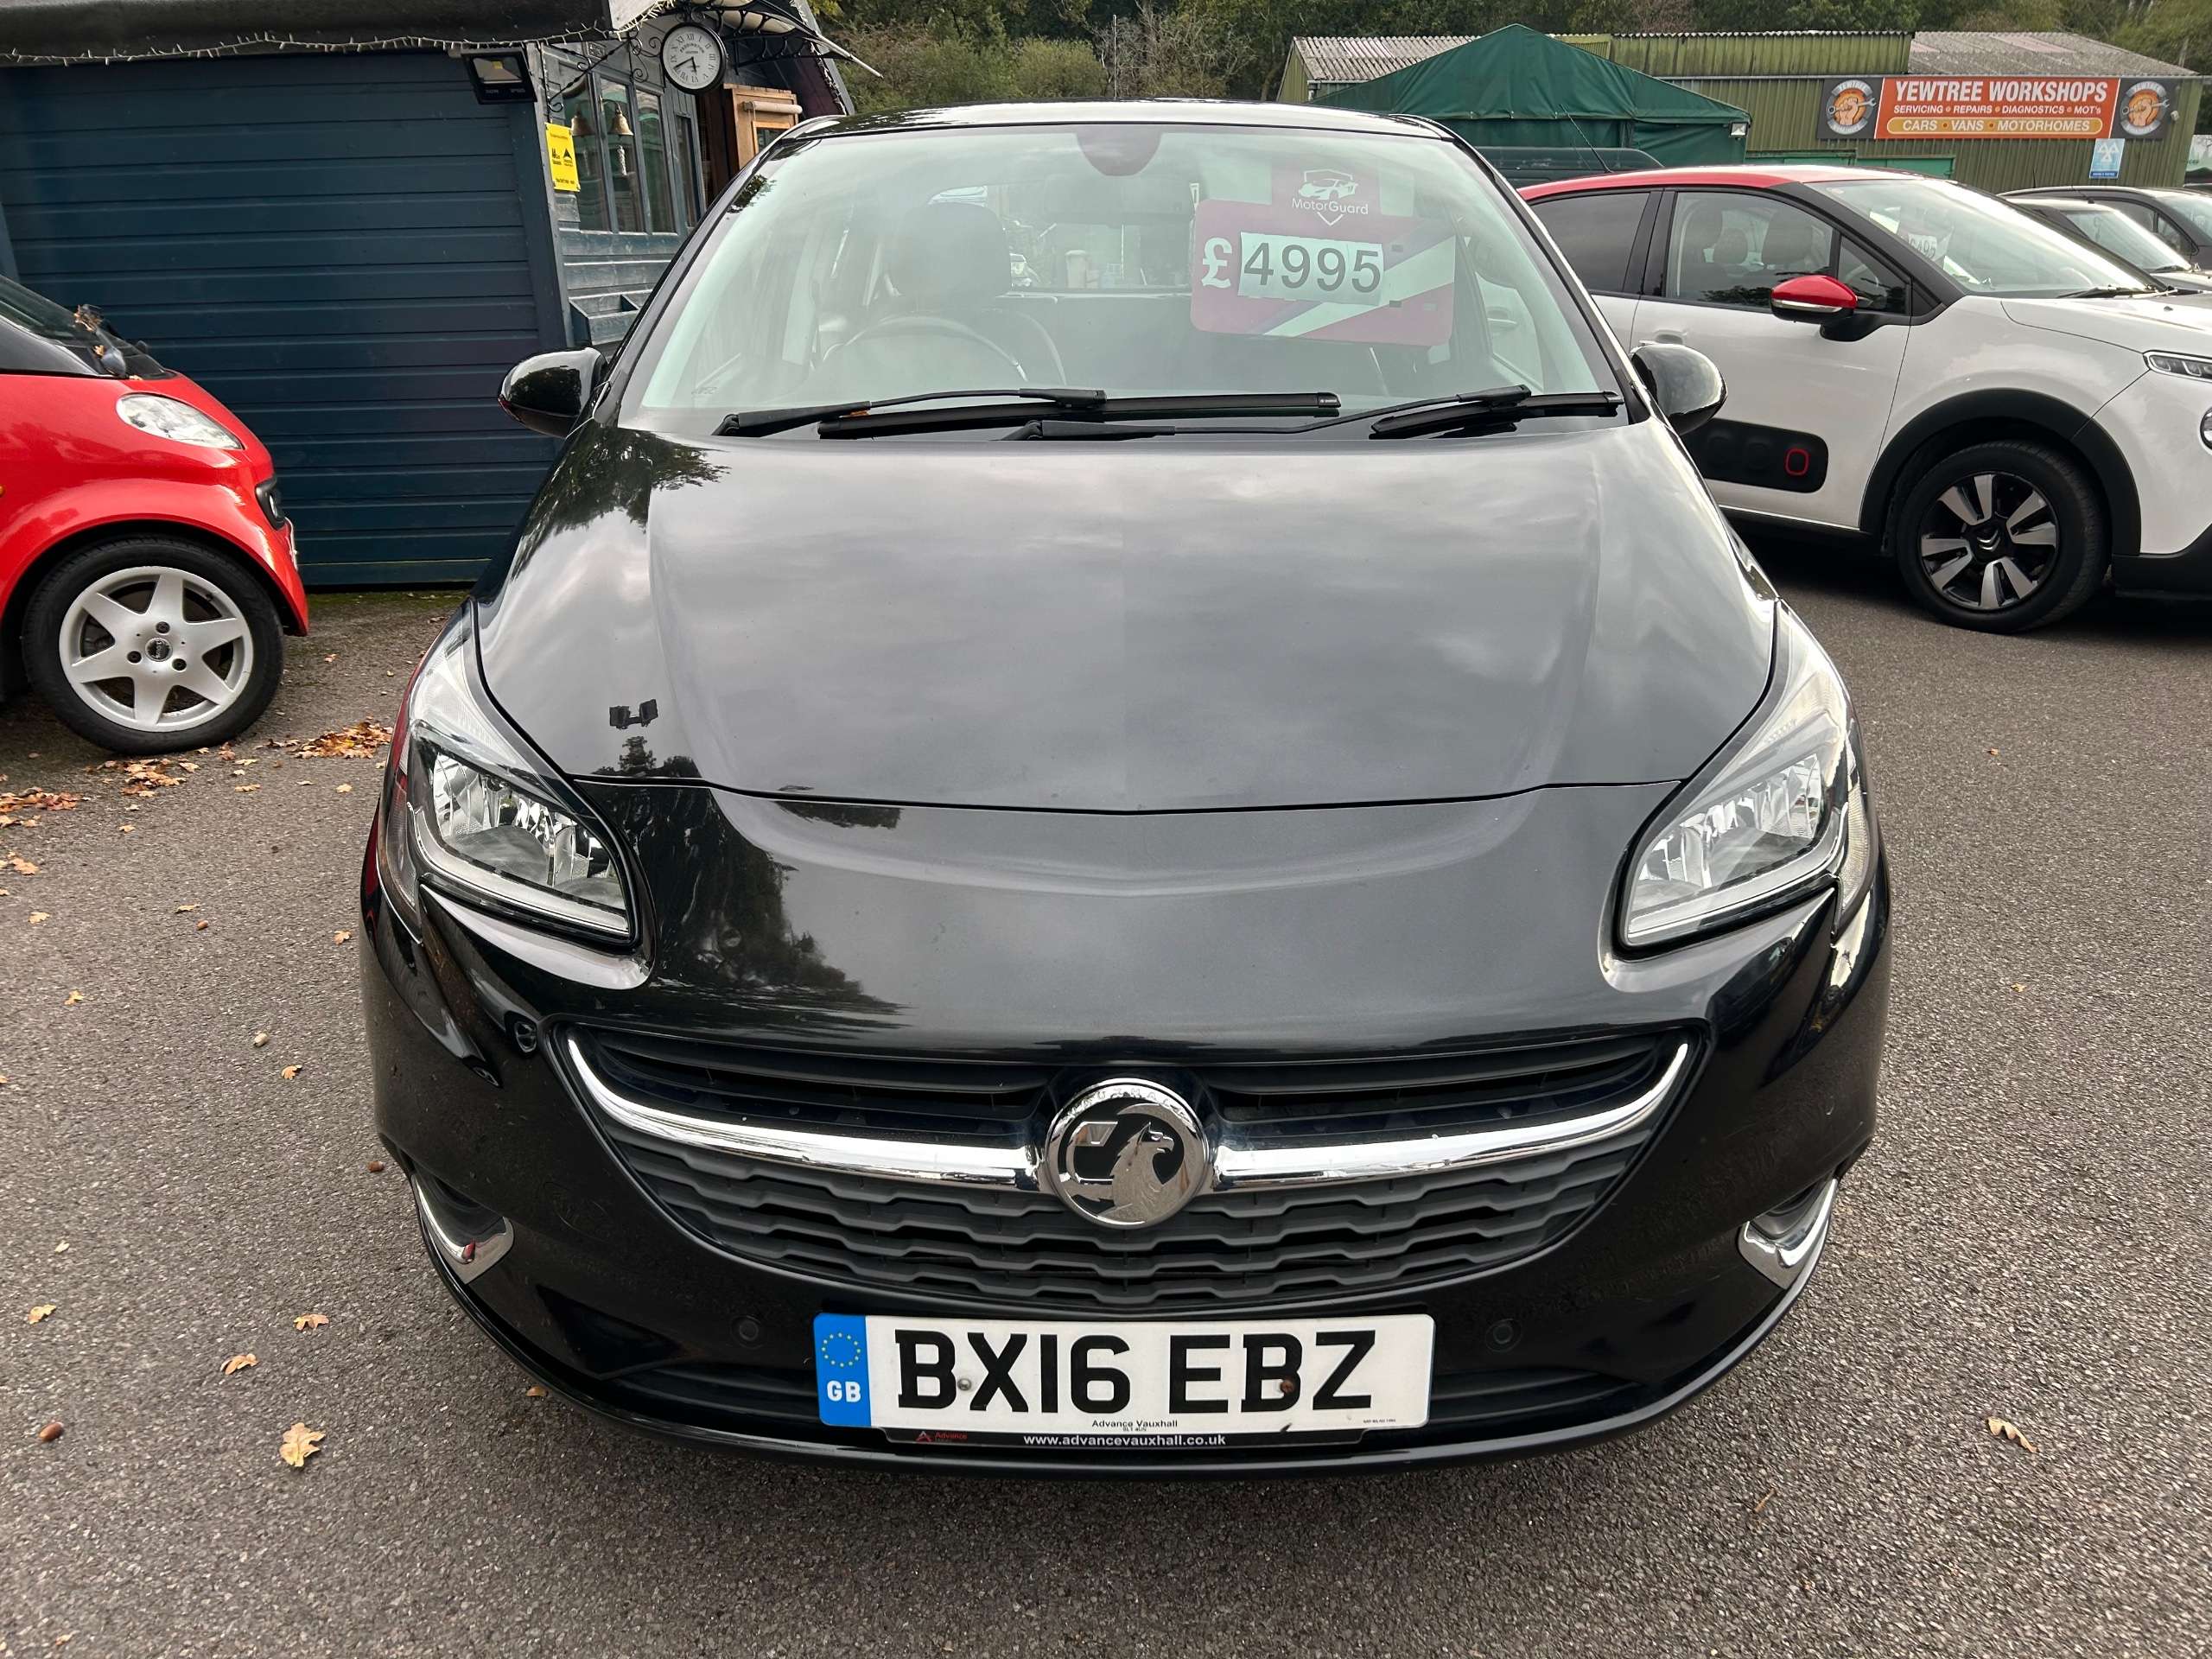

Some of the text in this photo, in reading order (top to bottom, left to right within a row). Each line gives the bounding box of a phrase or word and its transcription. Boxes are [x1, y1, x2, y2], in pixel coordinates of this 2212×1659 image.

[1896, 80, 2108, 102] YEWTREE WORKSHOPS
[1893, 105, 1943, 113] SERVICING
[1954, 105, 1993, 113] REPAIRS
[2002, 105, 2064, 114] DIAGNOSTICS
[1903, 120, 2090, 131] CARS VANS MOTORHOMES
[1292, 198, 1368, 215] MotorGuard
[894, 1329, 1376, 1414] BX16 EBZ
[827, 1381, 861, 1402] GB
[1092, 1419, 1178, 1427] Advance Vauxhall
[1023, 1433, 1226, 1446] www.advancevauxhall.co.uk
